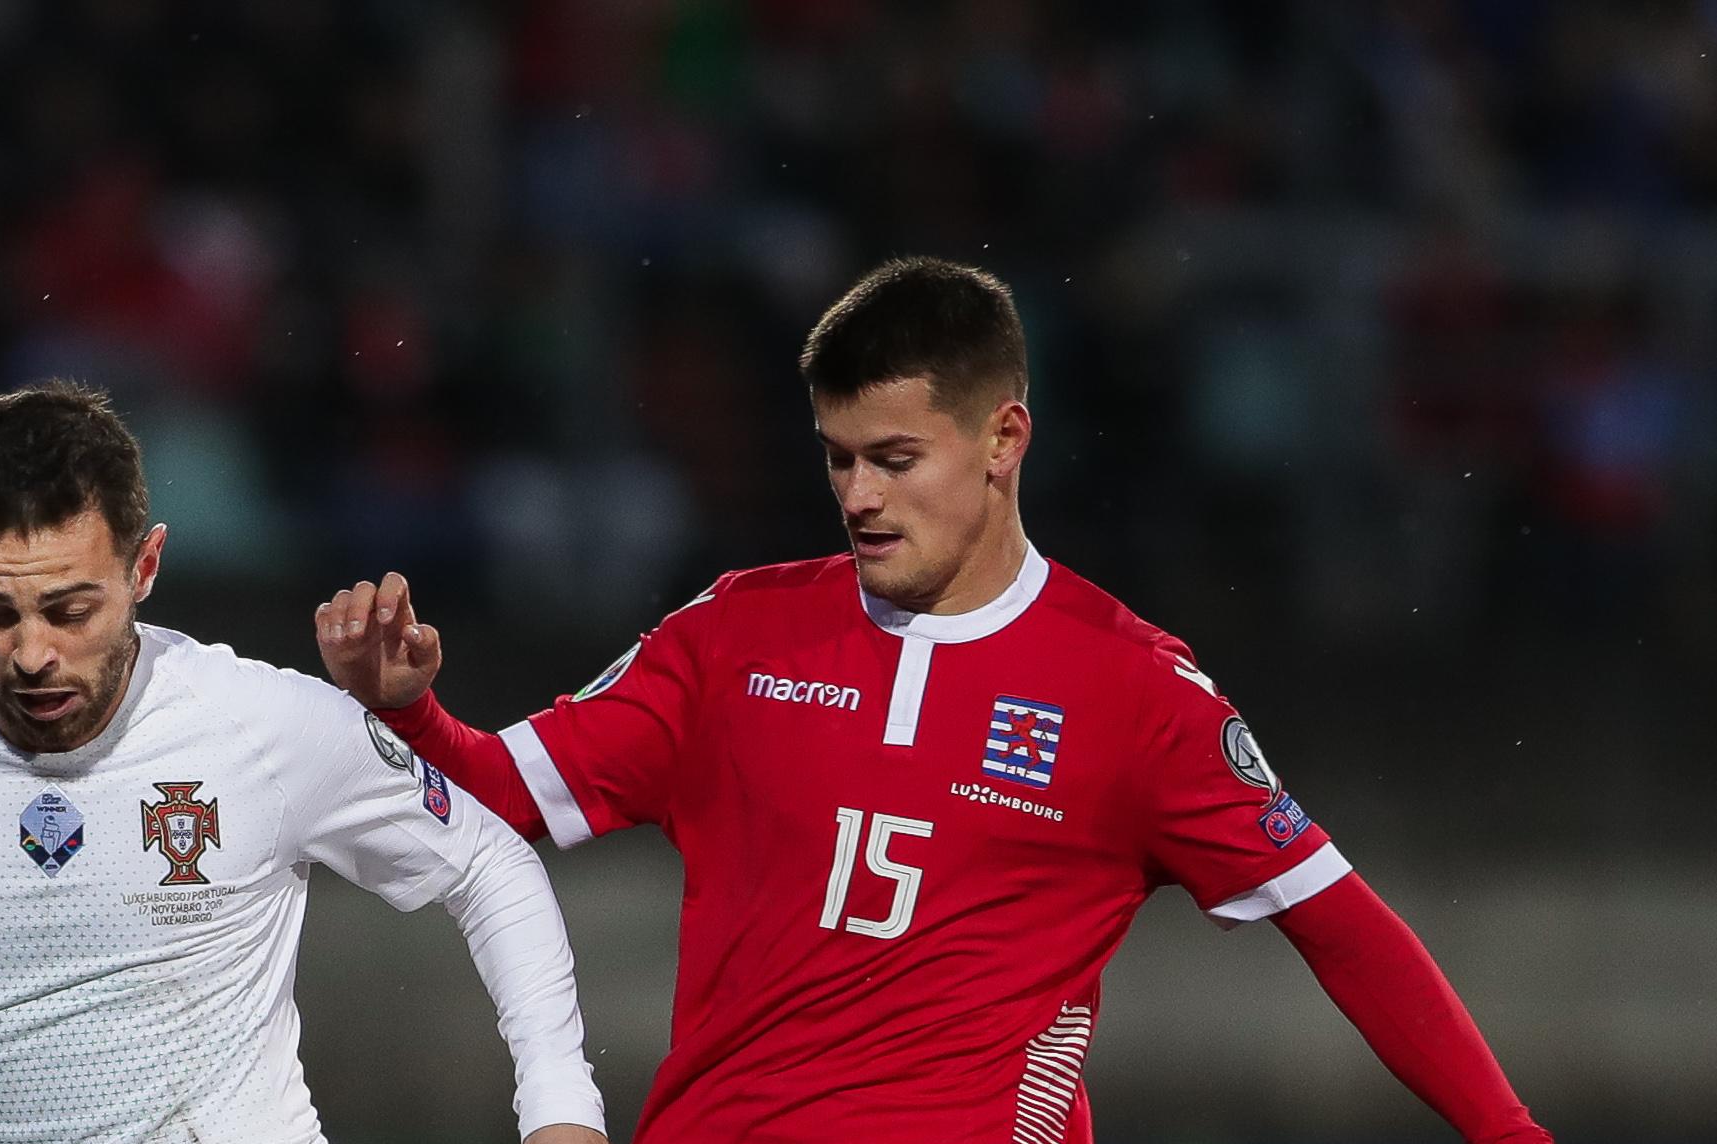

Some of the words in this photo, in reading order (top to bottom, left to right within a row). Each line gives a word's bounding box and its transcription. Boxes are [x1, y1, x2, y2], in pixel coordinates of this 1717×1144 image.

[747, 673, 861, 711] macron
[36, 805, 67, 813] WINNER
[950, 783, 1064, 822] LUXEMBOURG
[818, 806, 934, 940] 15
[151, 902, 202, 915] NOVEMBRO
[151, 911, 213, 926] LUXEMBURGO
